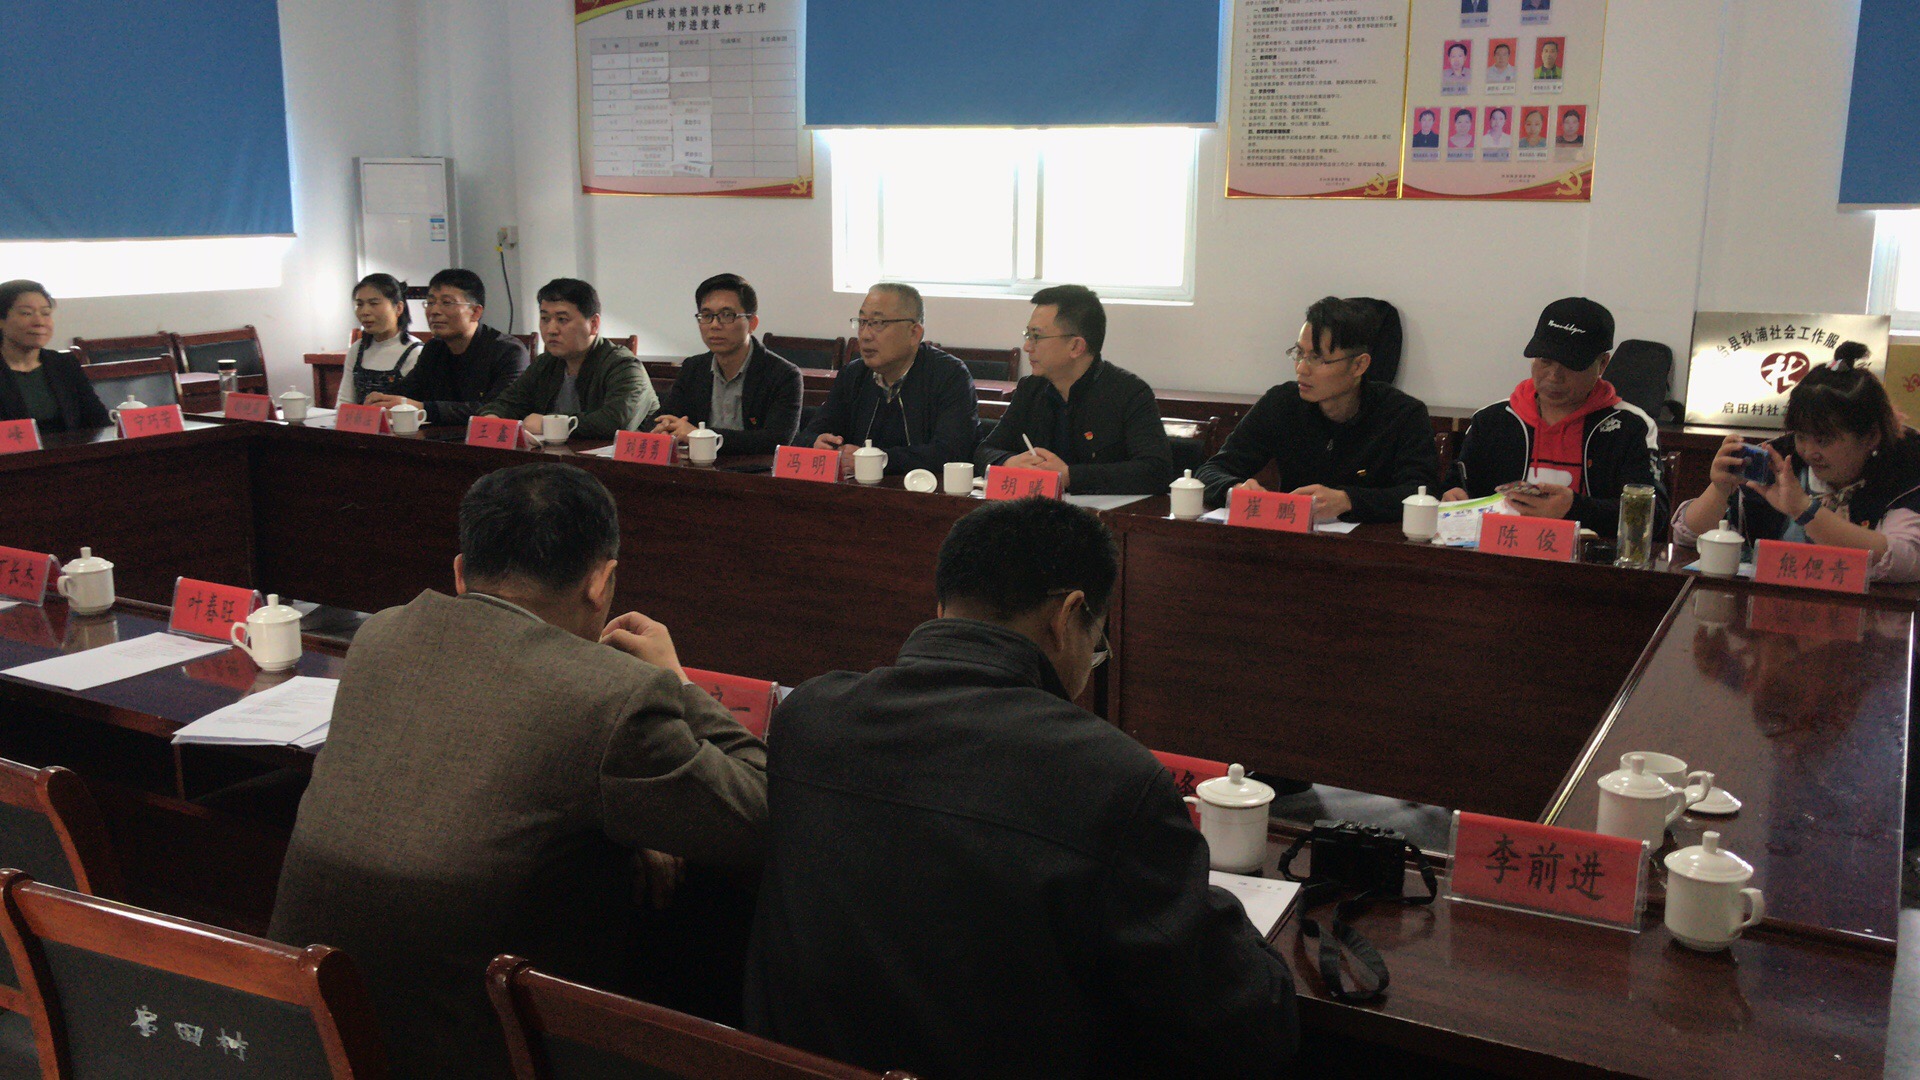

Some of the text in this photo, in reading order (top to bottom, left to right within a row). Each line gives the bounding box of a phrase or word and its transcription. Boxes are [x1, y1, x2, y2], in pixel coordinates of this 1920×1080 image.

[667, 19, 721, 32] 时序进度表
[1722, 401, 1790, 418] 启田村社
[787, 452, 827, 476] 冯明
[1243, 495, 1297, 525] 崔鹏
[1497, 524, 1559, 555] 陈俊
[188, 591, 236, 624] 叶春旺
[1485, 833, 1606, 901] 李前进
